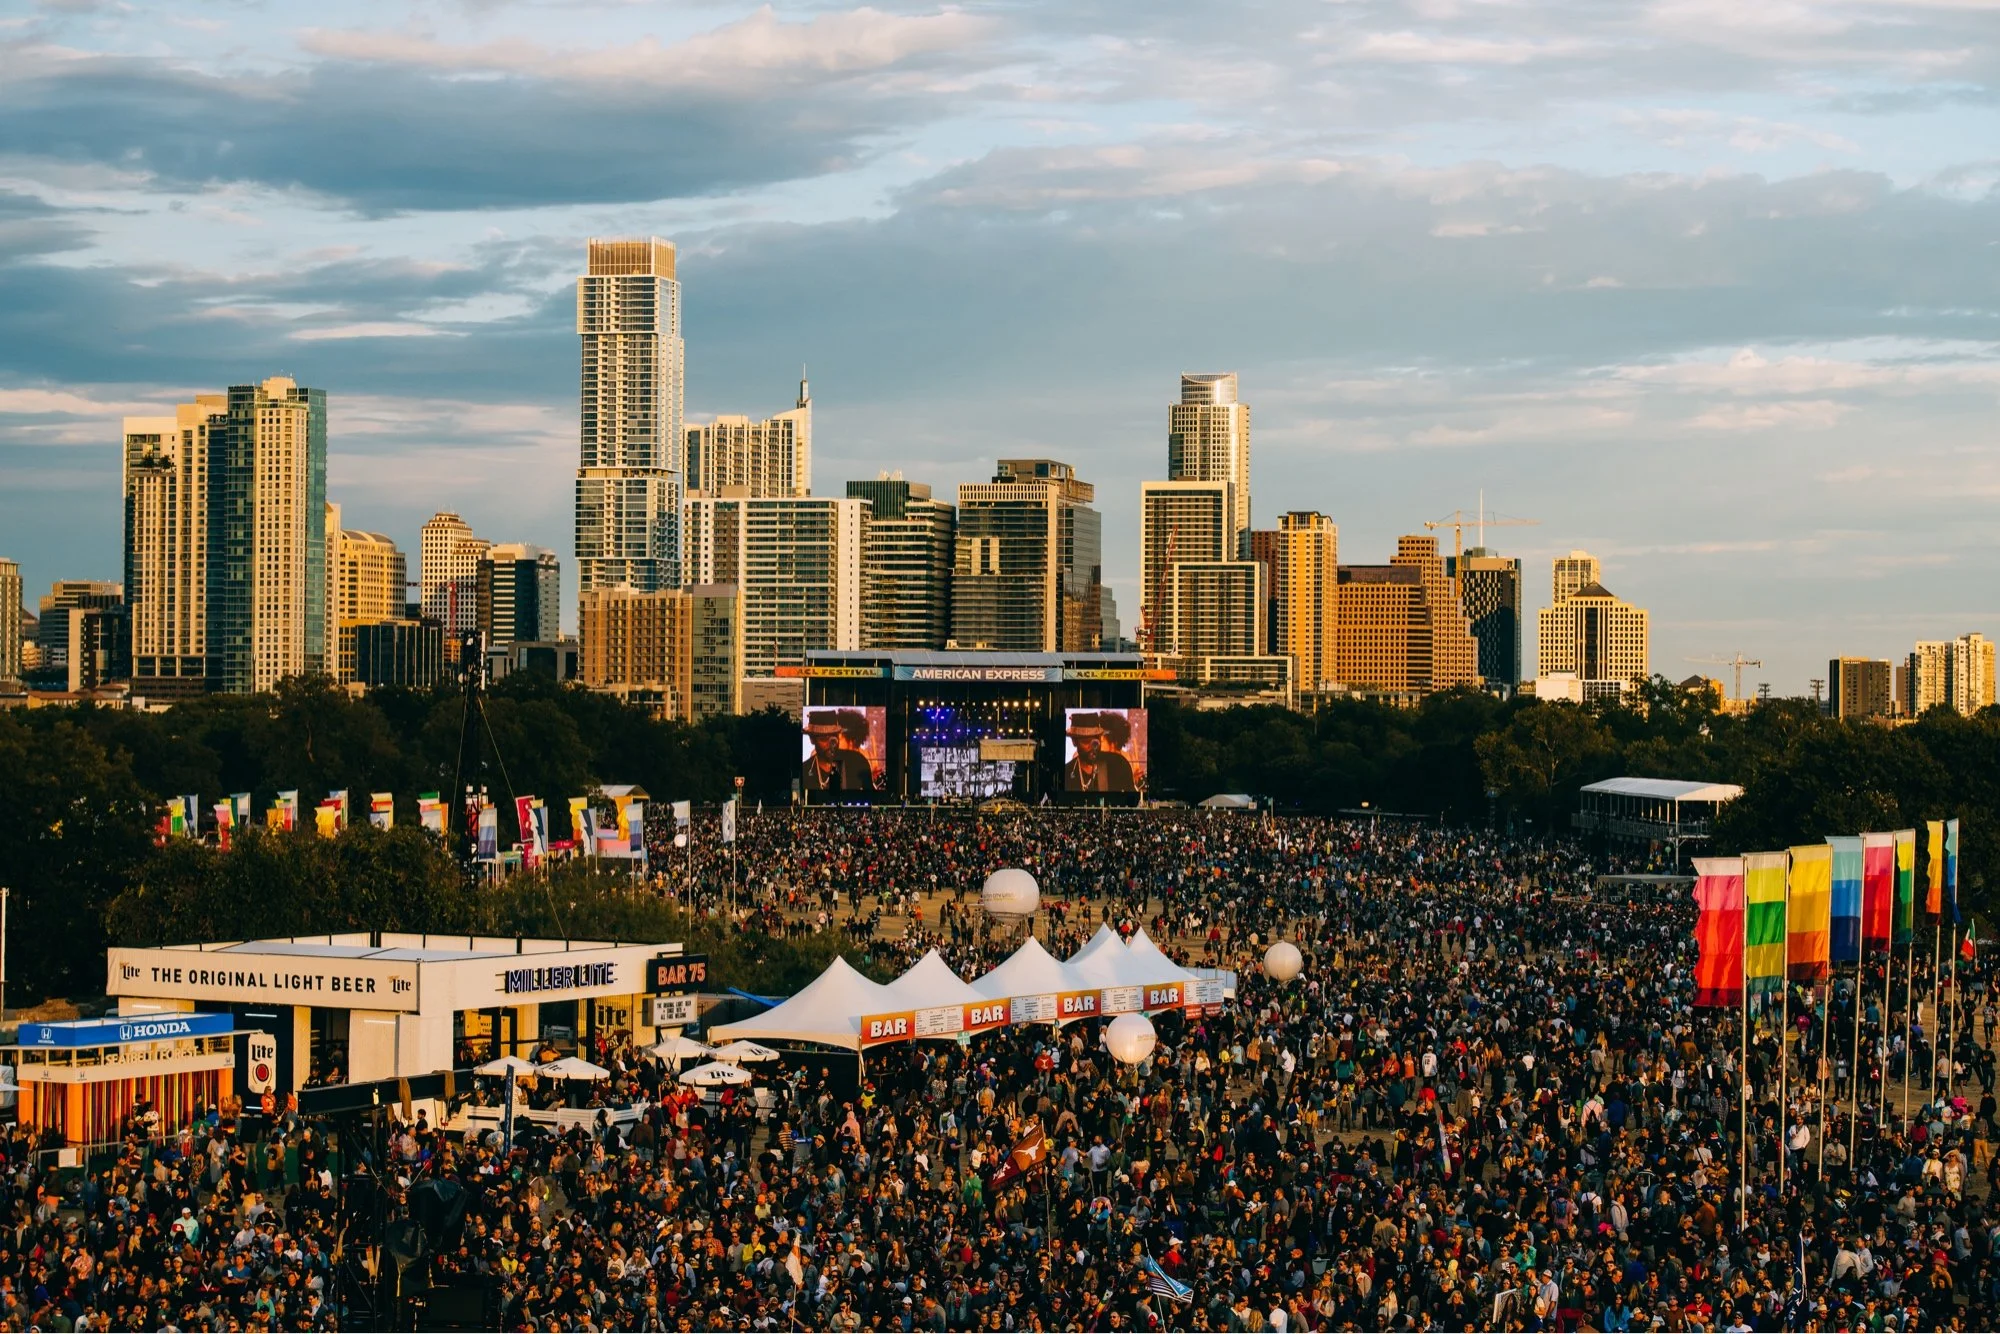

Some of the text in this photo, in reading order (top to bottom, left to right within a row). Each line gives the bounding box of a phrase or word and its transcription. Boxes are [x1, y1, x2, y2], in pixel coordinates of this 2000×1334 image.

[796, 668, 877, 676] ACL FESTIVAL
[912, 669, 1046, 680] AMERICAN EXPRESS
[1076, 670, 1098, 678] ACL
[122, 965, 140, 981] Lite
[151, 967, 376, 994] THE ORIGINAL LIGHT BEER
[507, 962, 615, 993] MILLER LITE
[657, 962, 706, 986] BAR 75
[391, 977, 412, 994] Lite
[1063, 995, 1095, 1014] BAR
[1150, 988, 1179, 1005] BAR
[597, 1005, 627, 1026] ite
[970, 1005, 1004, 1026] BAR
[133, 1021, 191, 1037] HONDA
[870, 1018, 907, 1038] BAR
[252, 1044, 274, 1062] Lite
[711, 1070, 734, 1080] Lite
